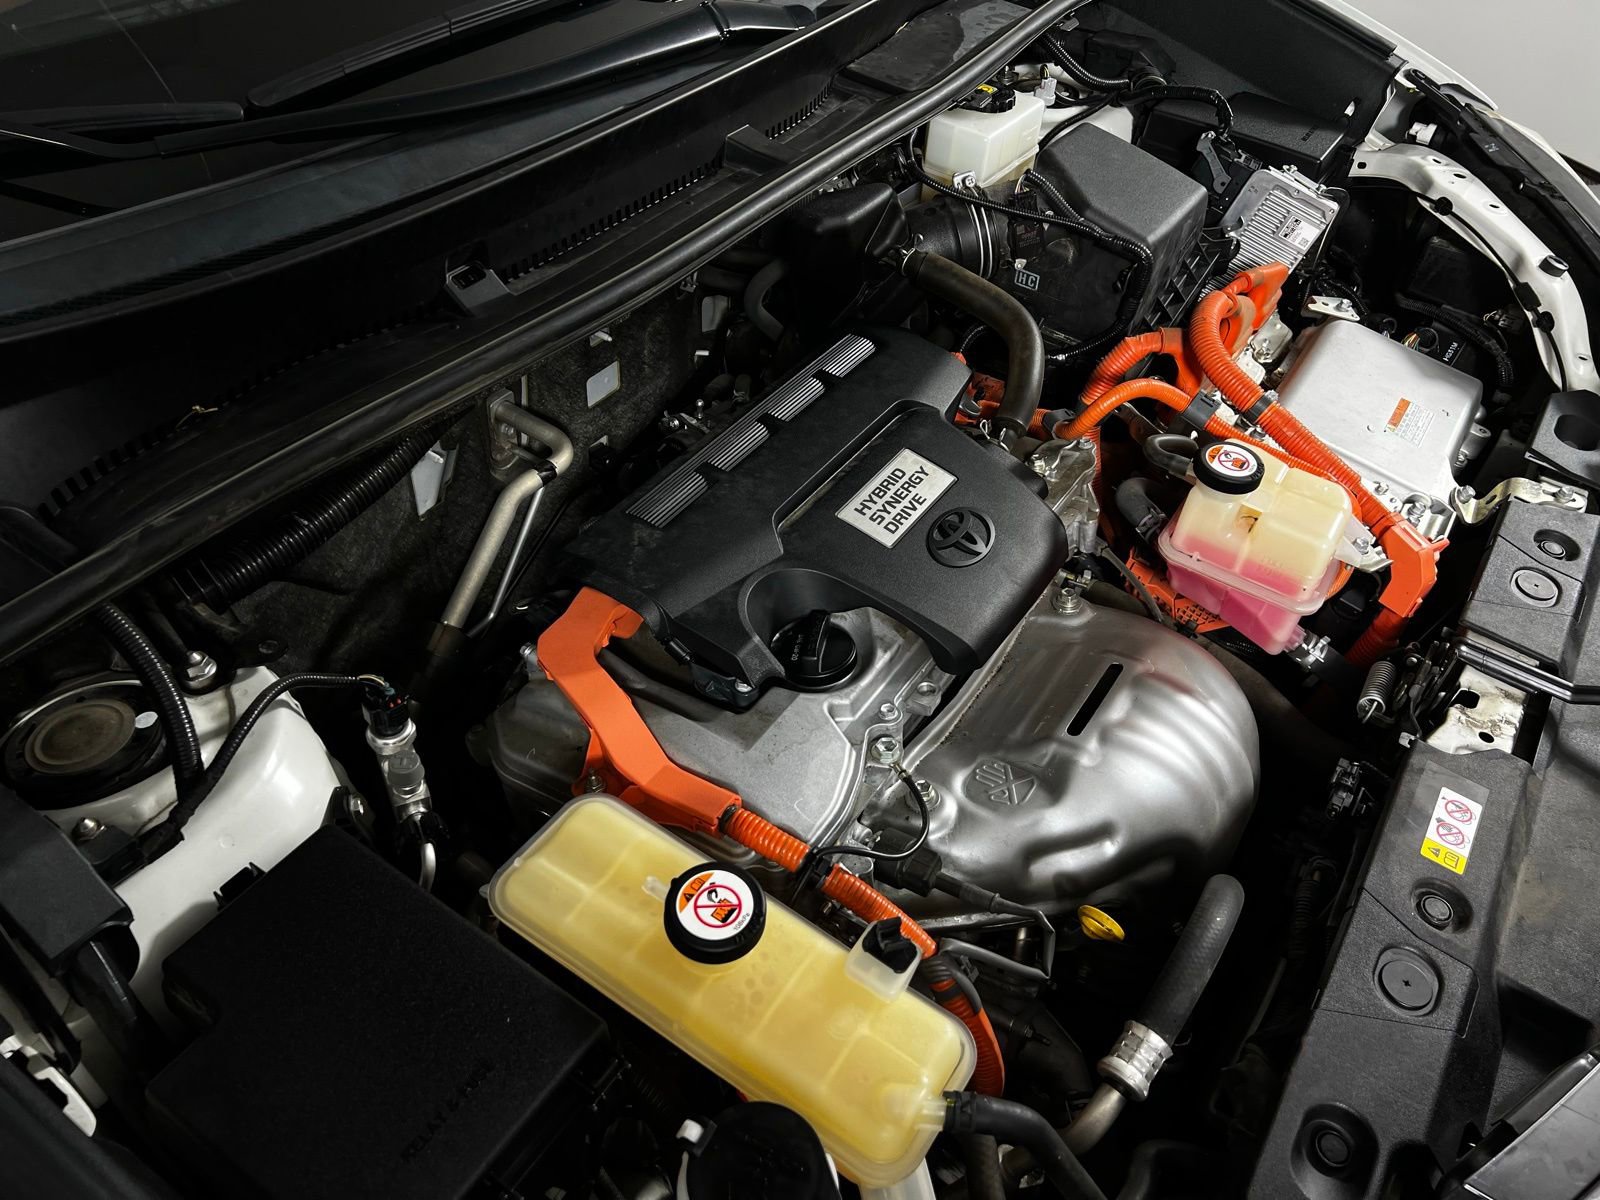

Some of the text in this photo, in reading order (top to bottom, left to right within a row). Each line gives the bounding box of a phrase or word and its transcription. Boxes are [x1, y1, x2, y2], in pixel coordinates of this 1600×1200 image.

[1018, 273, 1036, 288] HC
[853, 467, 906, 516] HYBRID
[868, 466, 930, 526] SYNERGY
[883, 492, 927, 535] DRIVE
